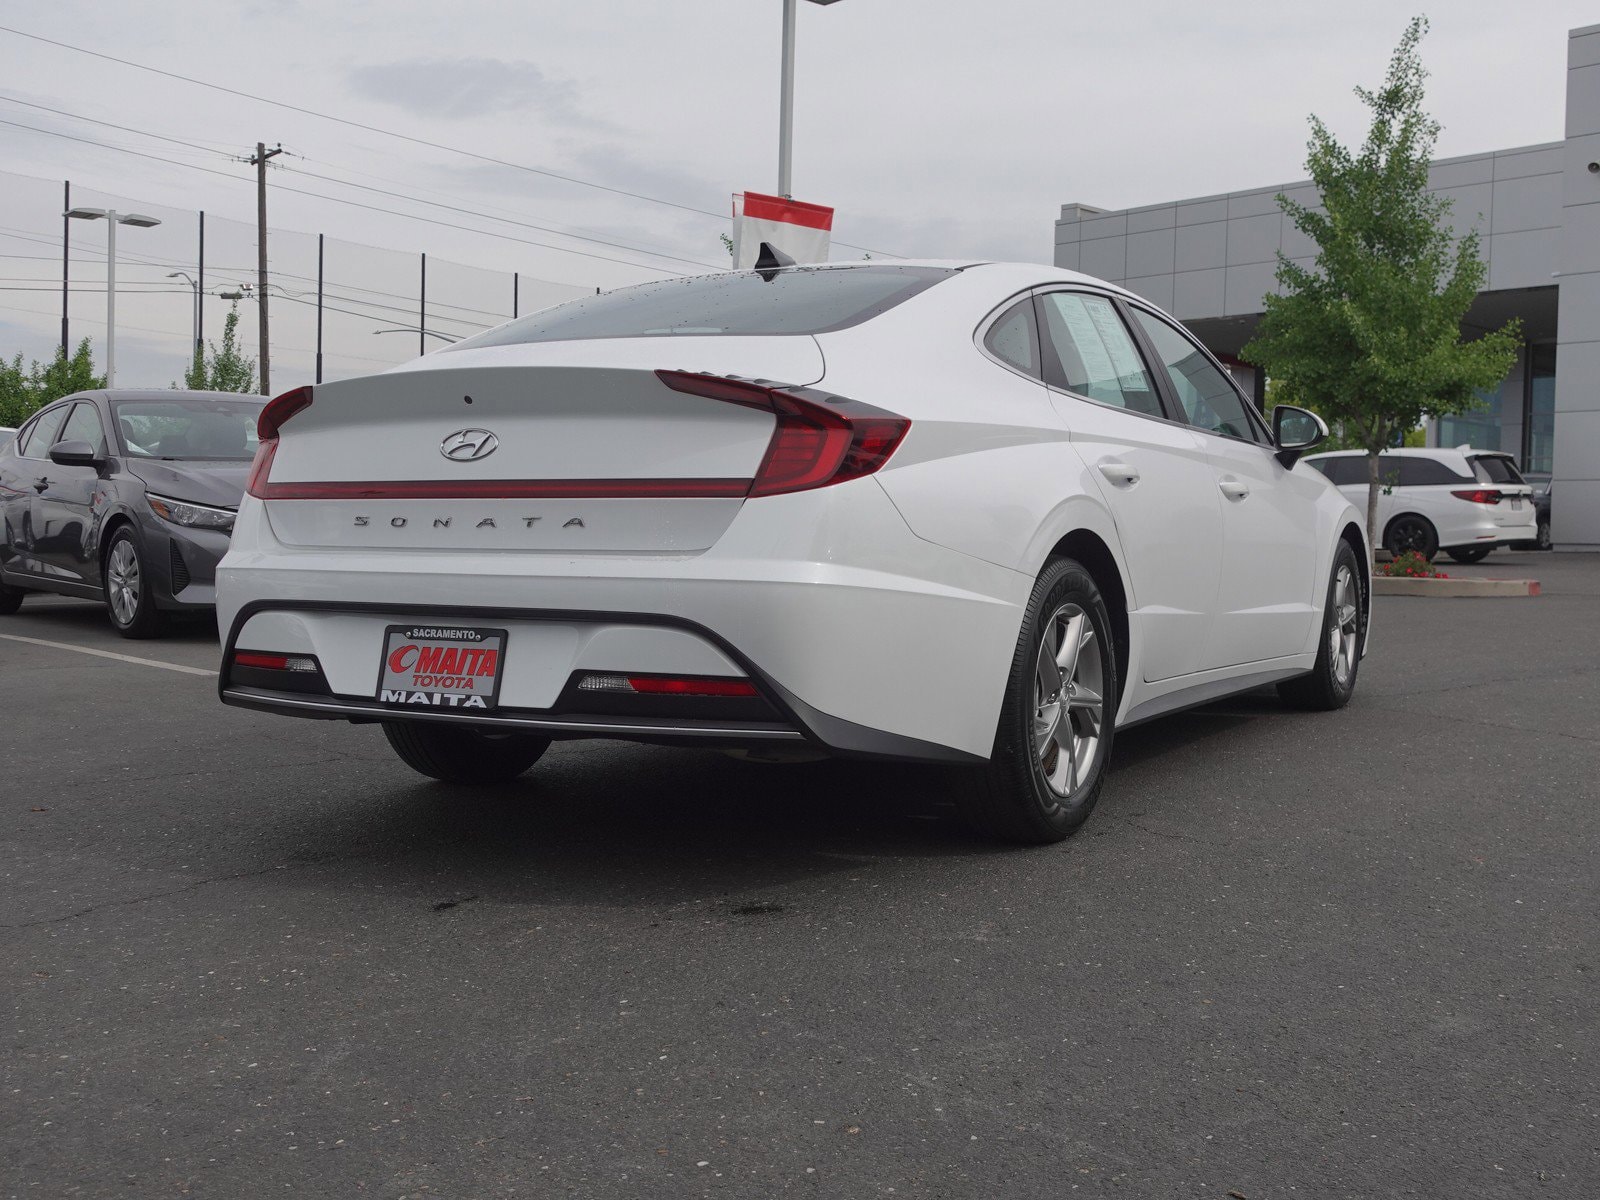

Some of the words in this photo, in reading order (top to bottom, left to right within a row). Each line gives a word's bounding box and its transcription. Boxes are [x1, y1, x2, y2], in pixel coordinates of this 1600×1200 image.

[353, 516, 585, 528] SONATA
[412, 628, 475, 639] SACRAMENTO
[412, 675, 474, 690] TOYOTA
[380, 690, 487, 708] MAITA
